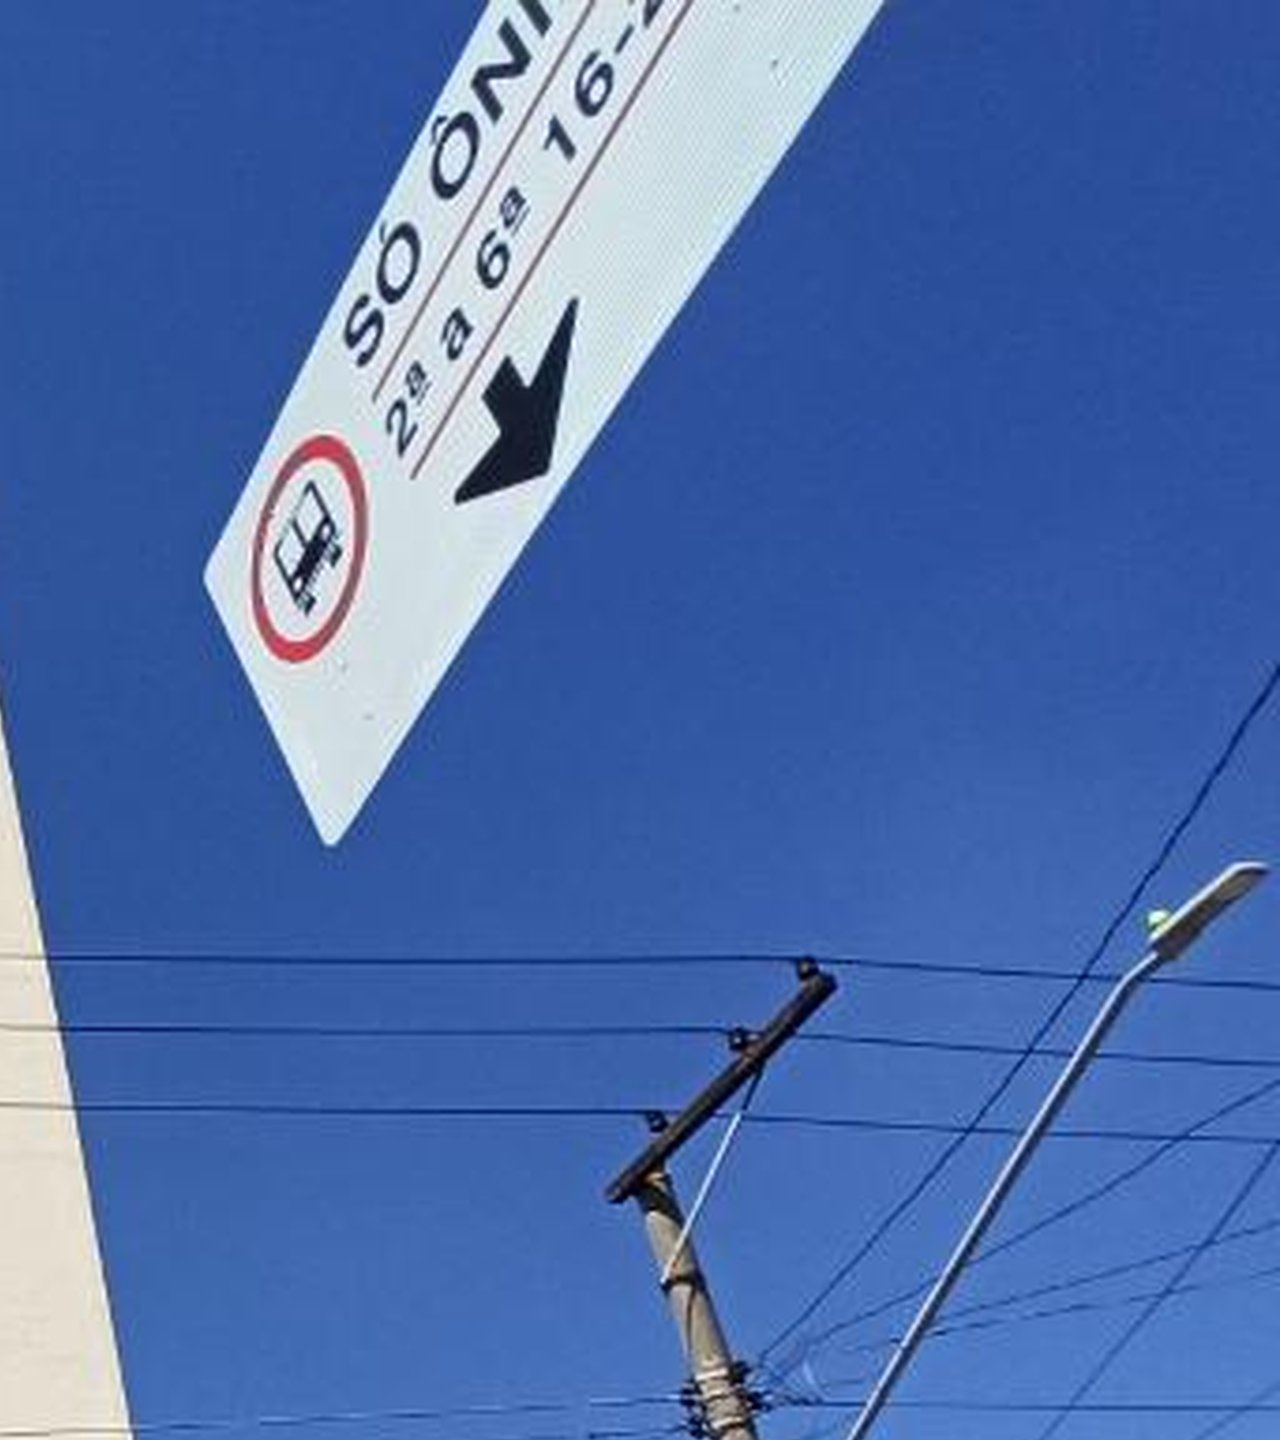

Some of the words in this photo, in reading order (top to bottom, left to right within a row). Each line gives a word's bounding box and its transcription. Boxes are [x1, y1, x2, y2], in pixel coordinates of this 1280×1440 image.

[344, 220, 421, 369] SÓ
[386, 360, 432, 458] 2ª
[442, 307, 474, 362] a
[476, 186, 531, 290] 6ª
